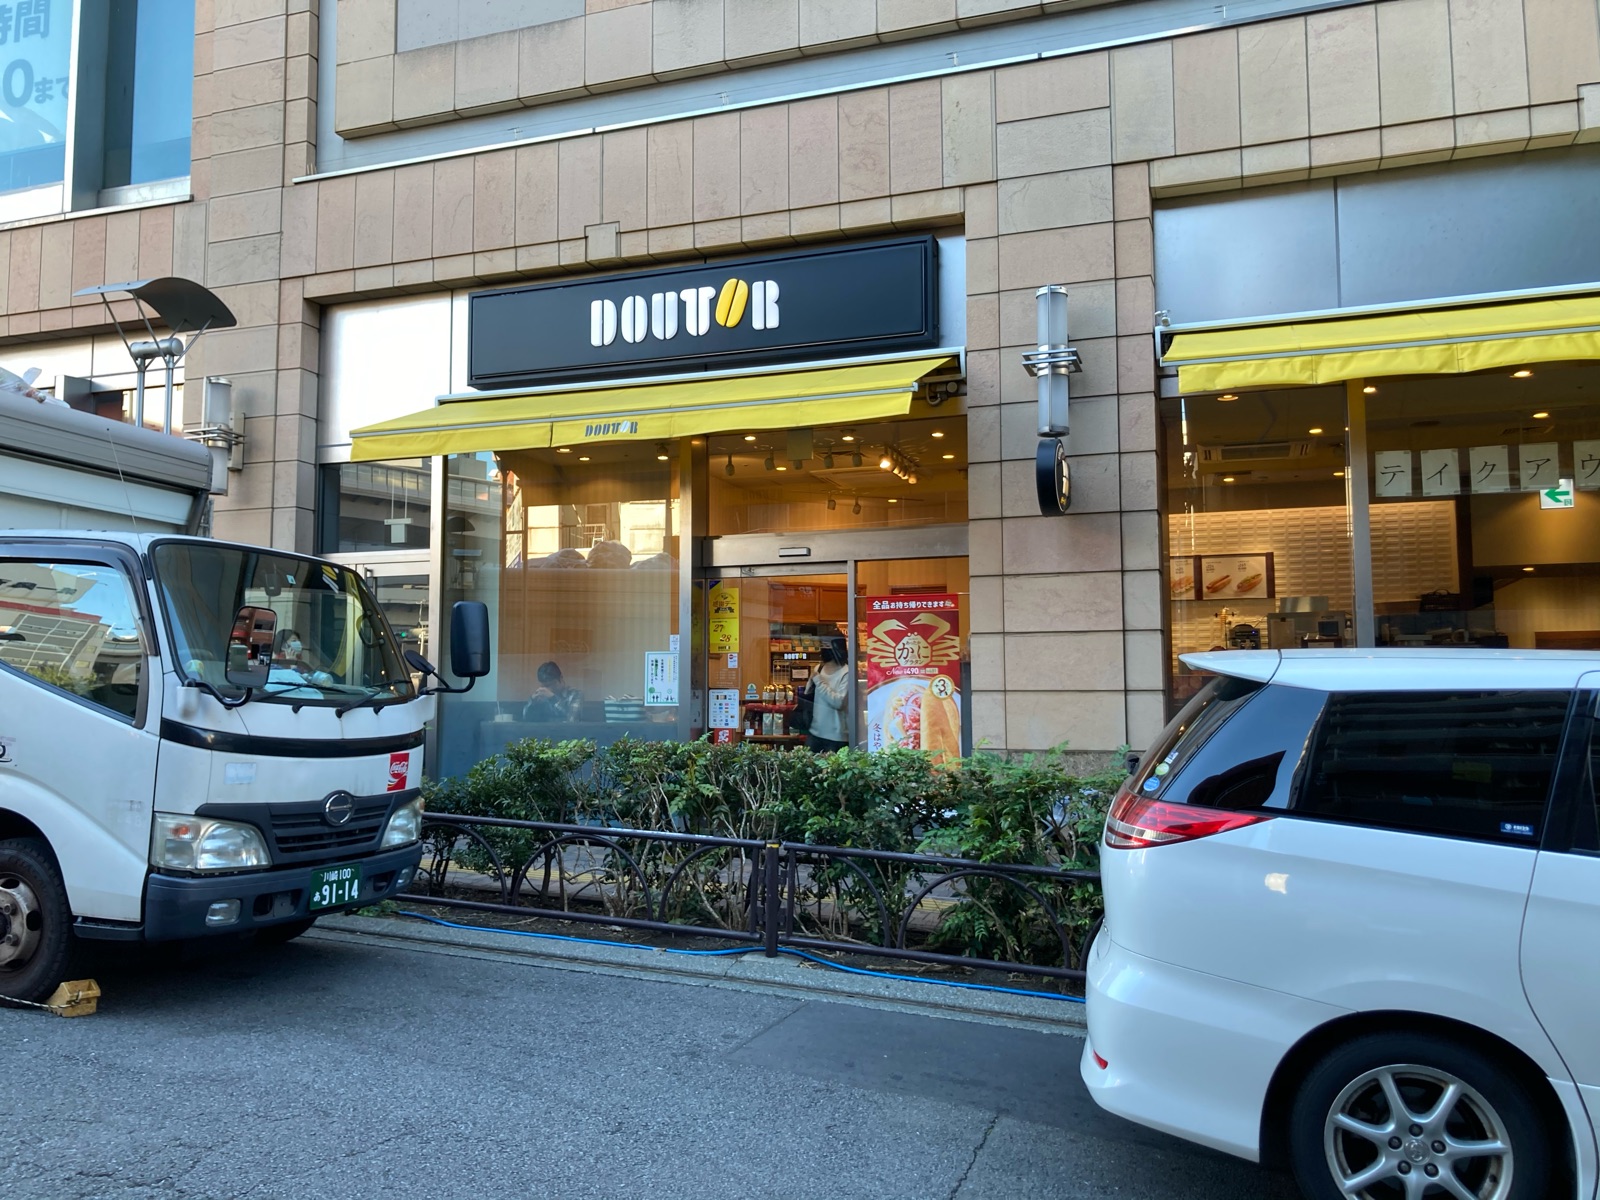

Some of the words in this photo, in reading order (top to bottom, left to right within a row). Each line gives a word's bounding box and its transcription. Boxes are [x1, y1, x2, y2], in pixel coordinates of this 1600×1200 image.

[591, 278, 780, 347] DOUTOR
[585, 420, 638, 437] DOUTOR
[897, 643, 929, 659] かに
[339, 868, 351, 880] 100
[321, 879, 359, 905] 91-14
